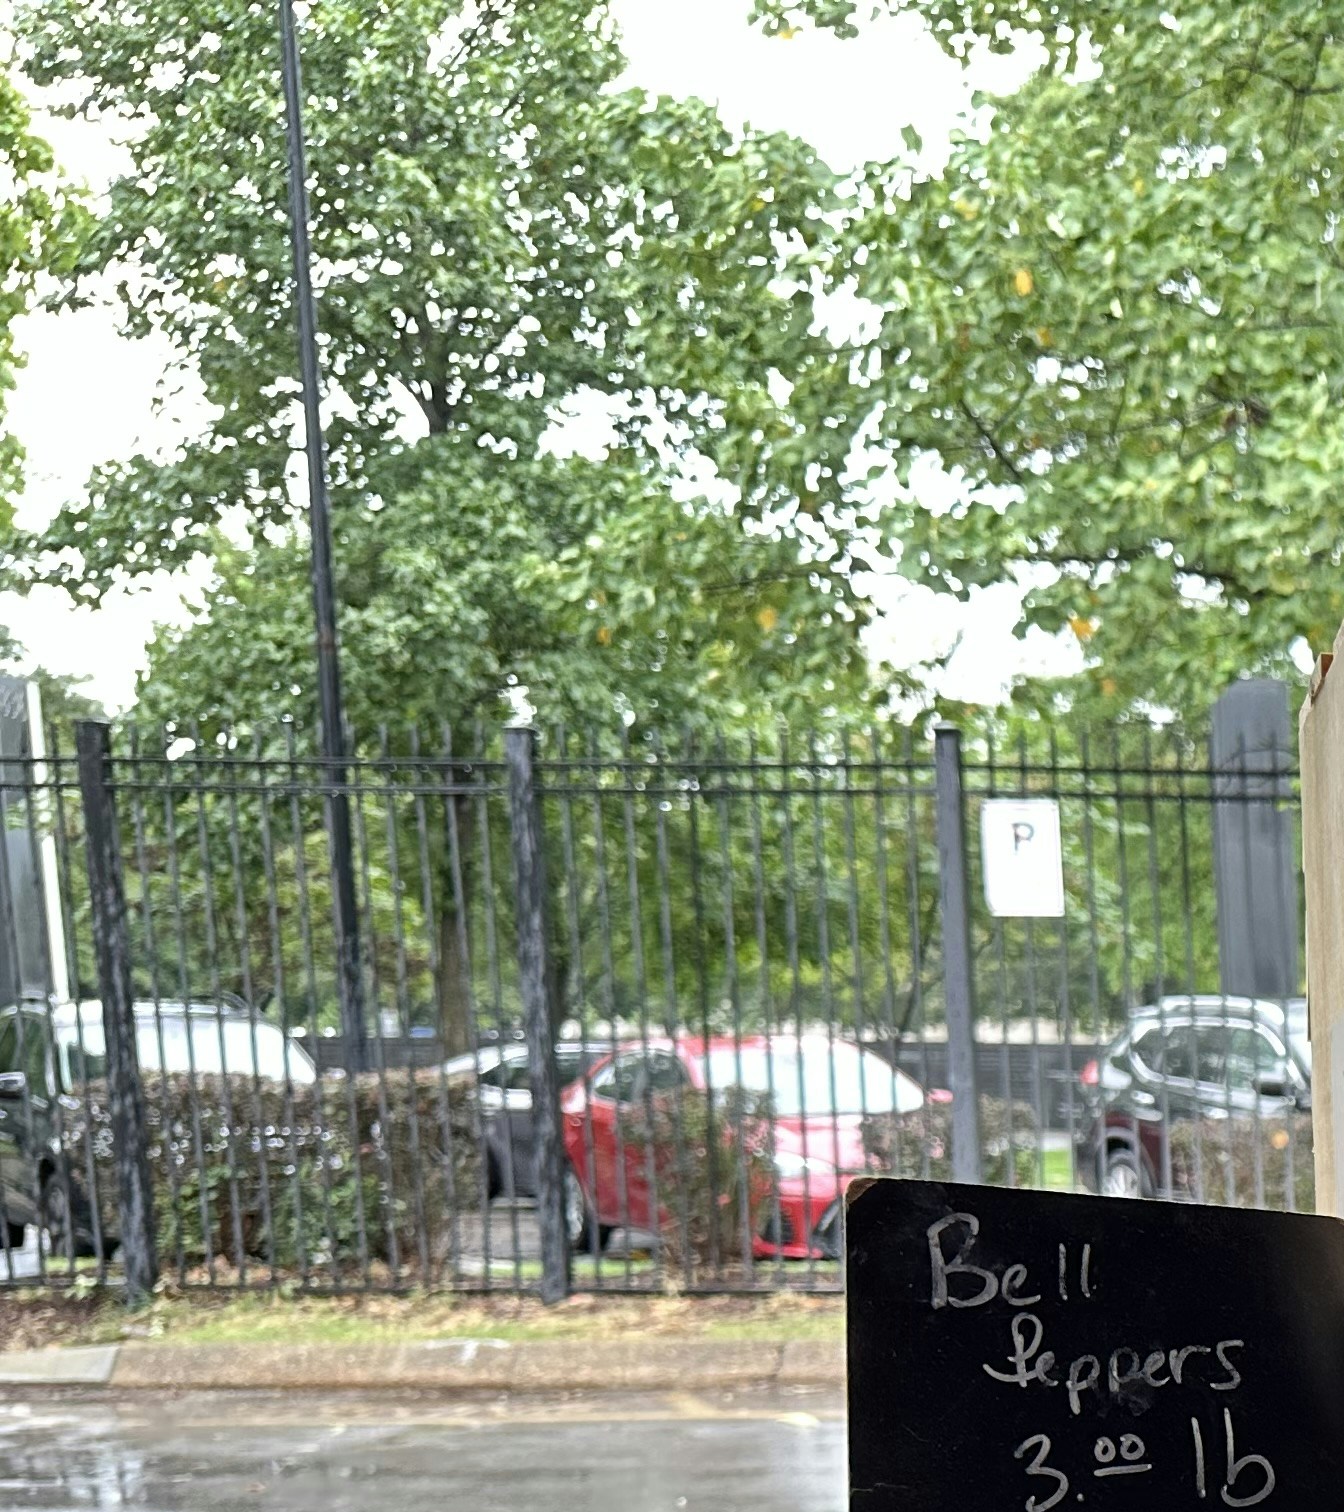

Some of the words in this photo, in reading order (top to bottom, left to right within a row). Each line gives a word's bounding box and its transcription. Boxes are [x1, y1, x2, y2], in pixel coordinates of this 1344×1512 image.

[1012, 823, 1034, 852] P
[926, 1213, 1091, 1309] Bell
[983, 1313, 1245, 1414] Peppers
[1191, 1407, 1276, 1508] lb
